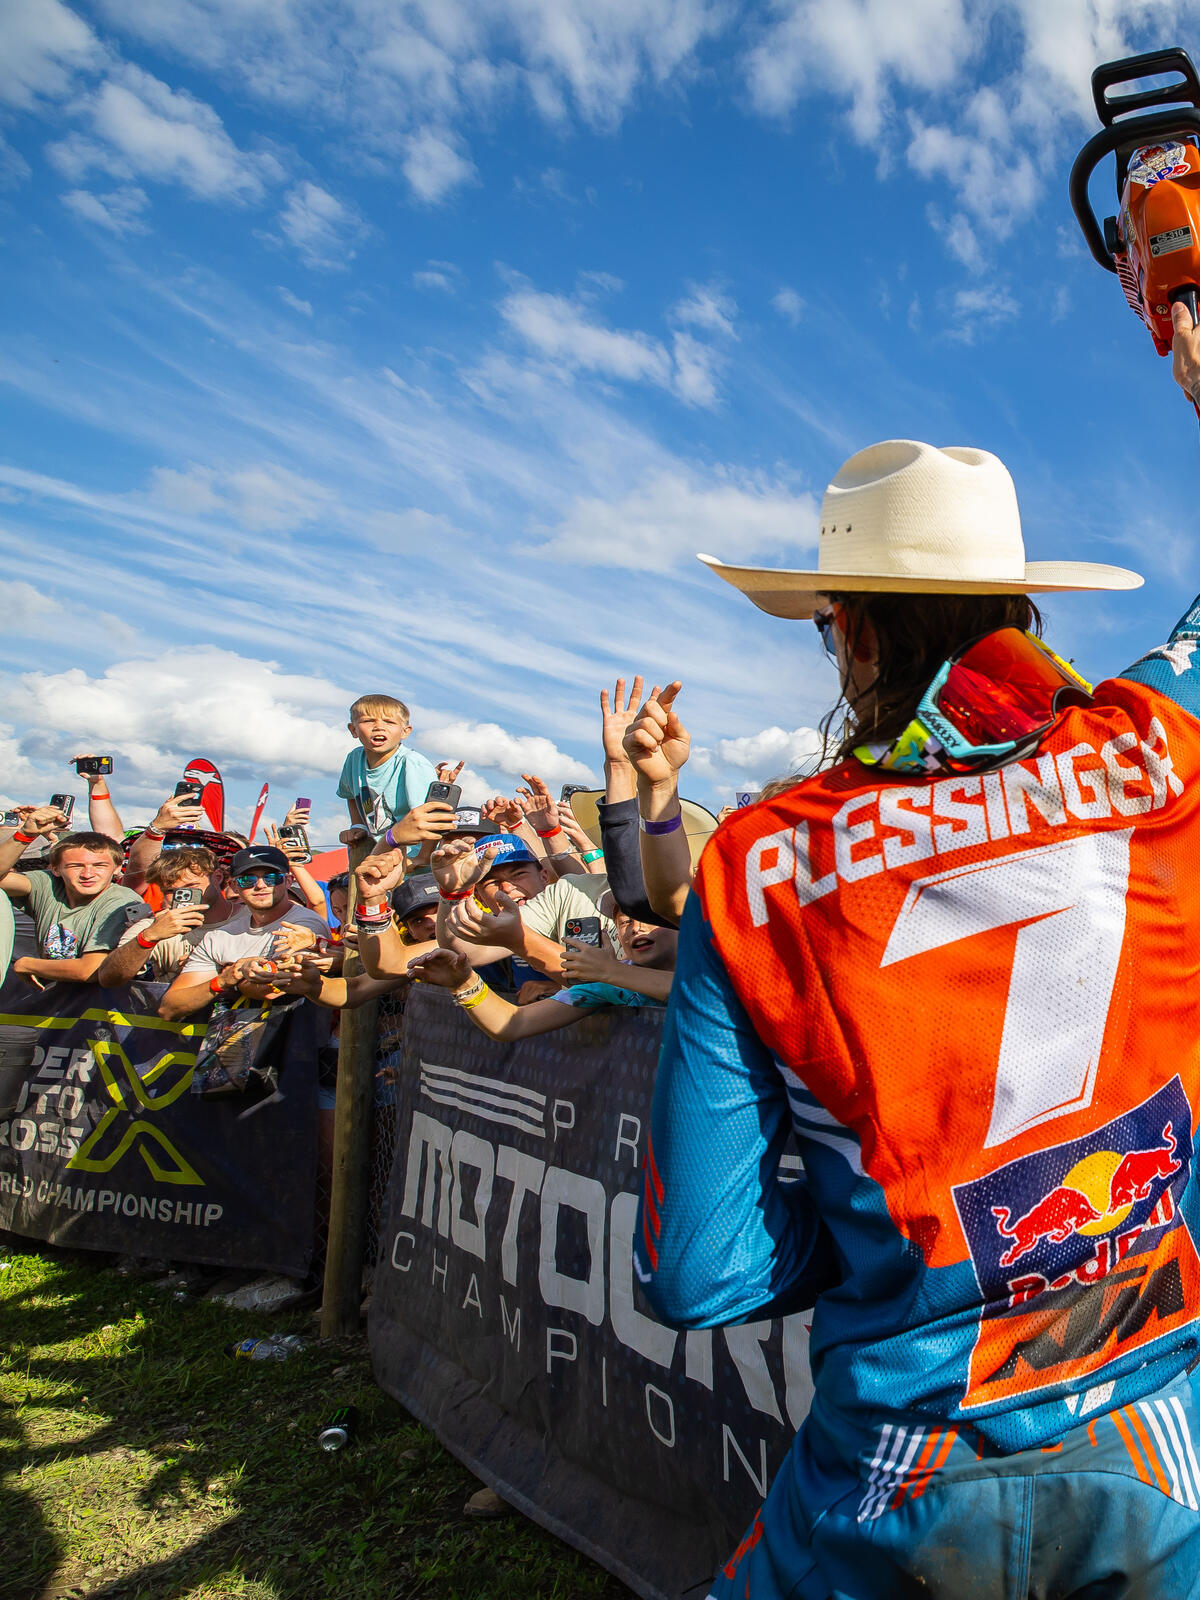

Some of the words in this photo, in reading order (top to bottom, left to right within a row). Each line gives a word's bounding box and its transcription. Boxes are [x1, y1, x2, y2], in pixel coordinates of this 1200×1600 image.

[1156, 229, 1184, 243] CS-310
[921, 711, 961, 748] OAKLEY
[745, 716, 1185, 928] PLESSINGER
[880, 826, 1136, 1149] 7
[36, 1180, 224, 1227] CHAMPIONSHIP
[979, 1257, 1186, 1385] KTM
